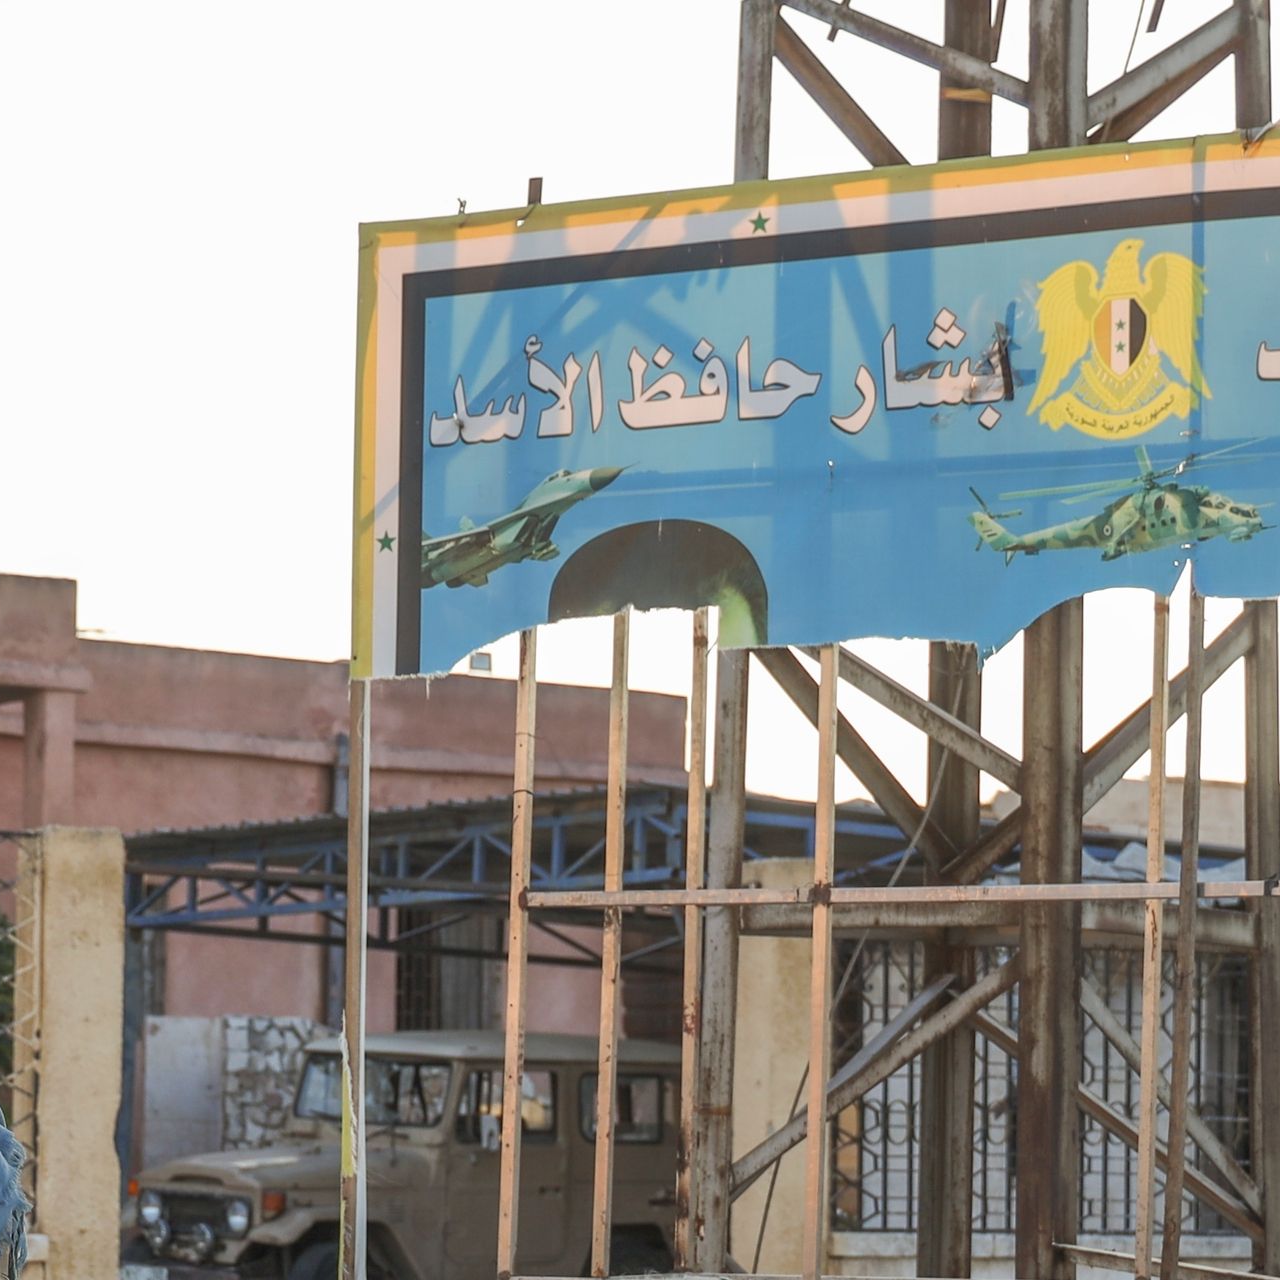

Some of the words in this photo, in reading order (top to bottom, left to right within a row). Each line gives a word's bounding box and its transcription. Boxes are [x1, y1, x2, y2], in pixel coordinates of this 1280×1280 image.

[429, 335, 605, 447] الأسد
[618, 335, 823, 431] حافظ
[830, 306, 1008, 435] بشار
